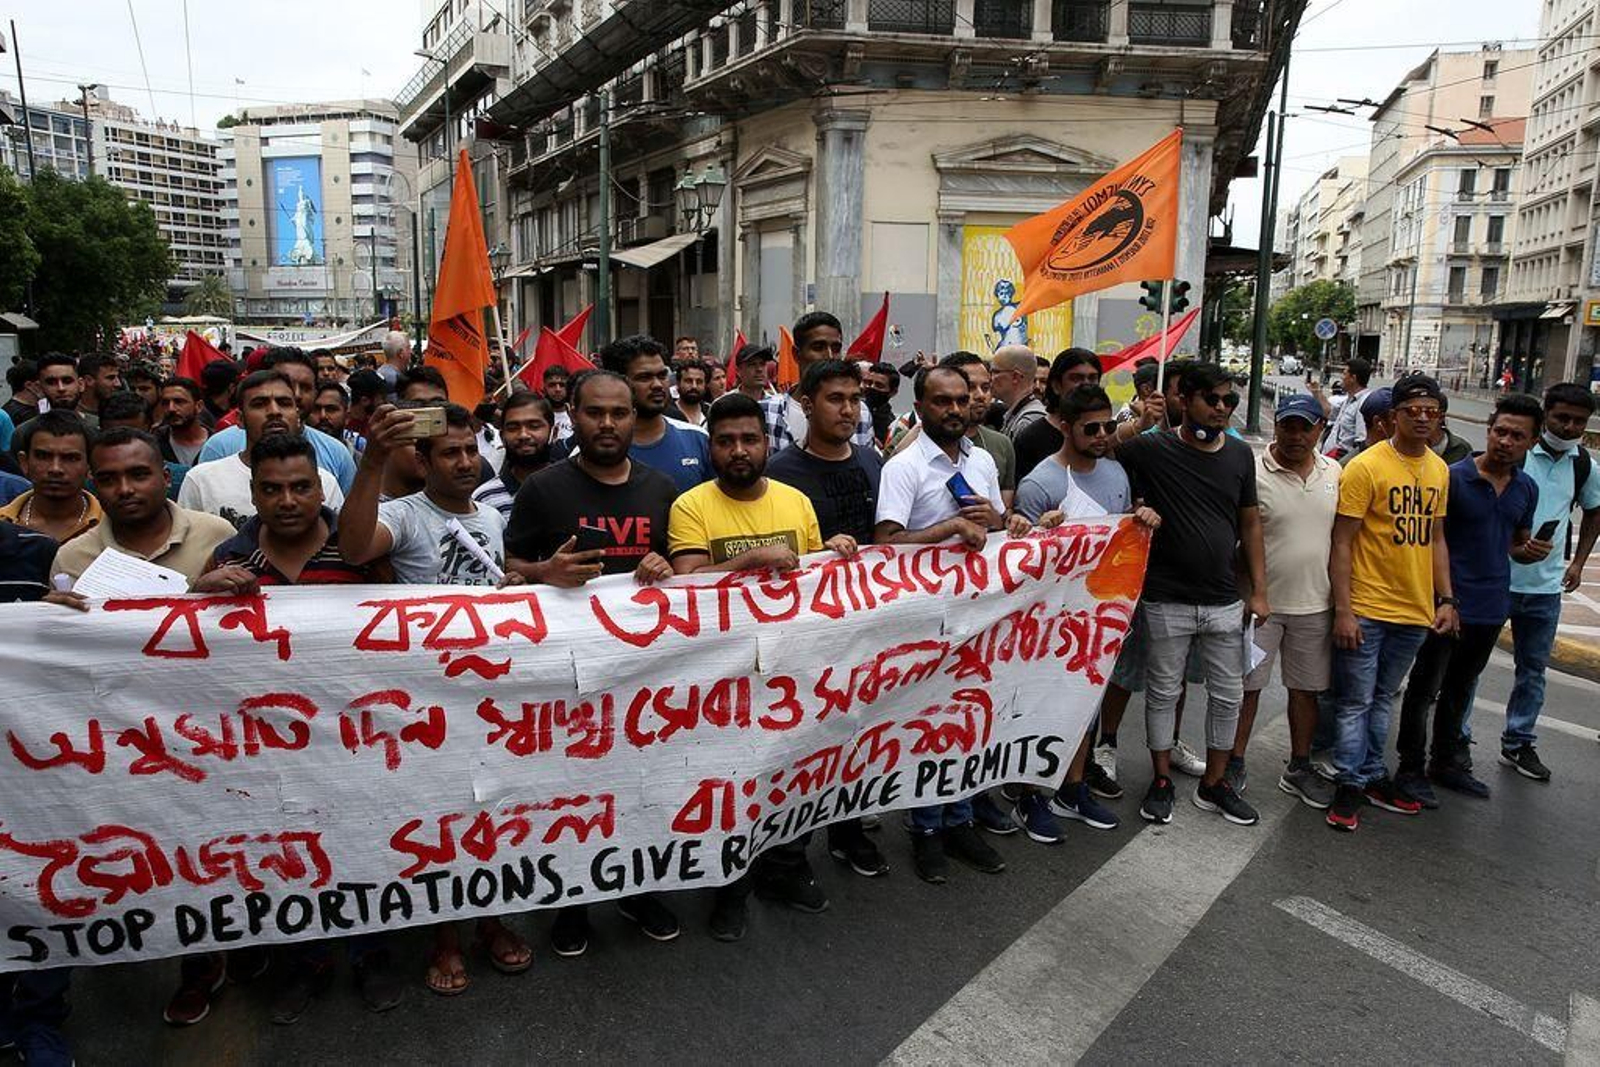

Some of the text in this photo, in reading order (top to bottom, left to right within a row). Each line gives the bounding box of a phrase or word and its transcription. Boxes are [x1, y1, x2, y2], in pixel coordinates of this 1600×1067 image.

[6, 907, 156, 965] STOP
[590, 834, 705, 892] GIVE
[721, 771, 903, 881] RESIDENCE
[913, 735, 1065, 799] PERMITS
